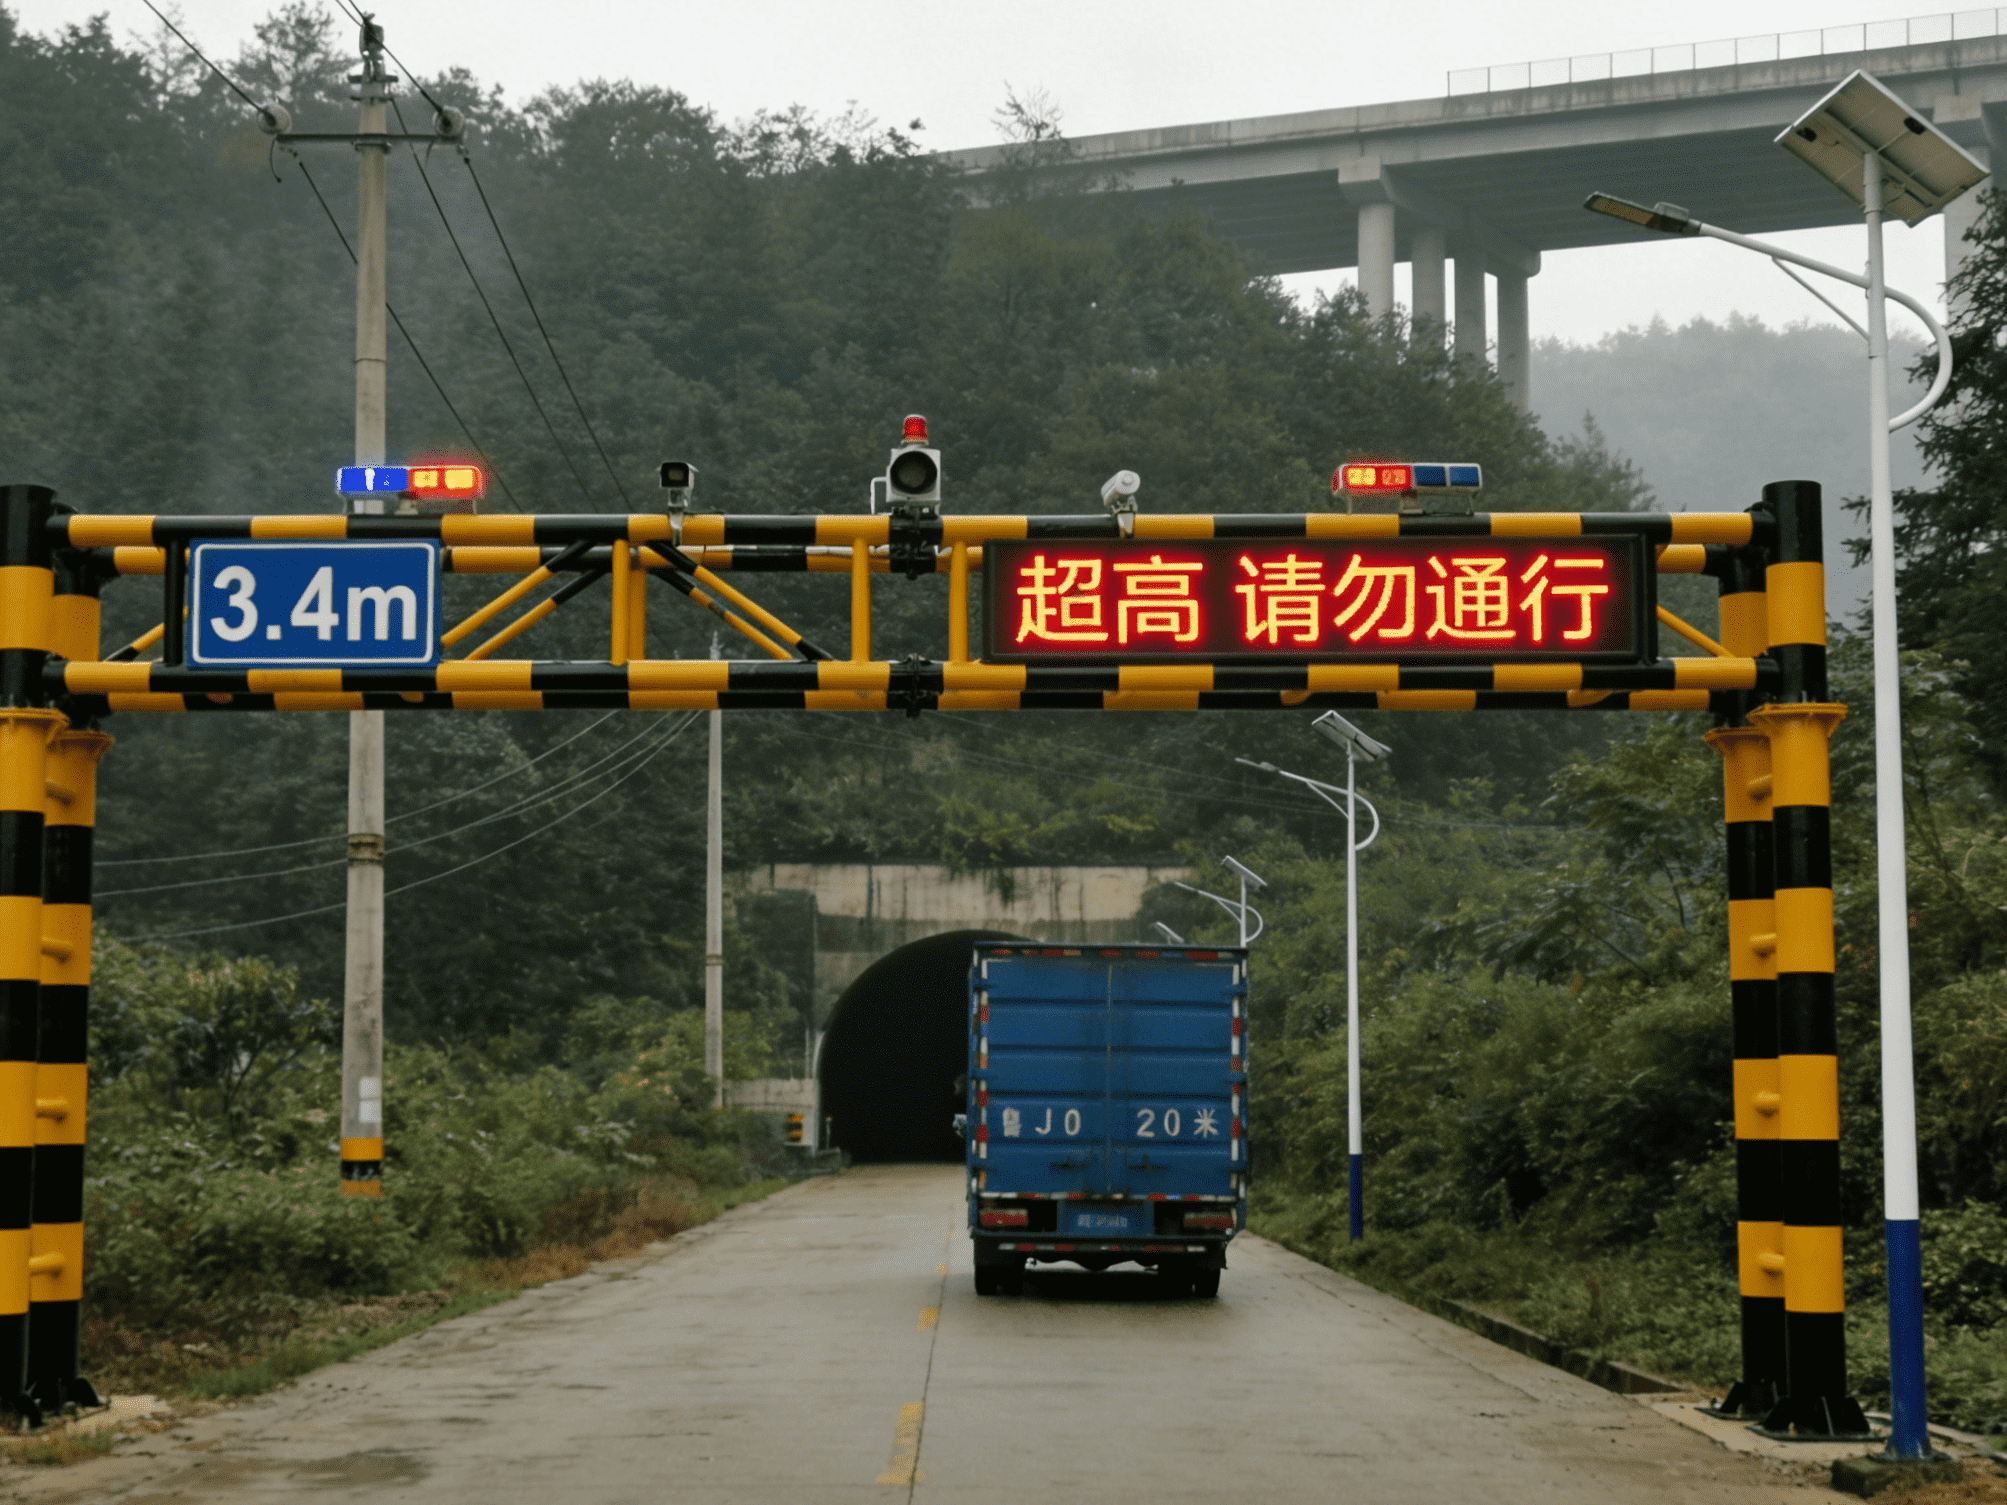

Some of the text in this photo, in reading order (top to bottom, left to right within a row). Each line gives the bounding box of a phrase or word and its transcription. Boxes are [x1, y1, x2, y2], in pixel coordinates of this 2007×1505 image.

[210, 565, 417, 642] 3.4m
[1015, 553, 1610, 645] 超高 请勿通行
